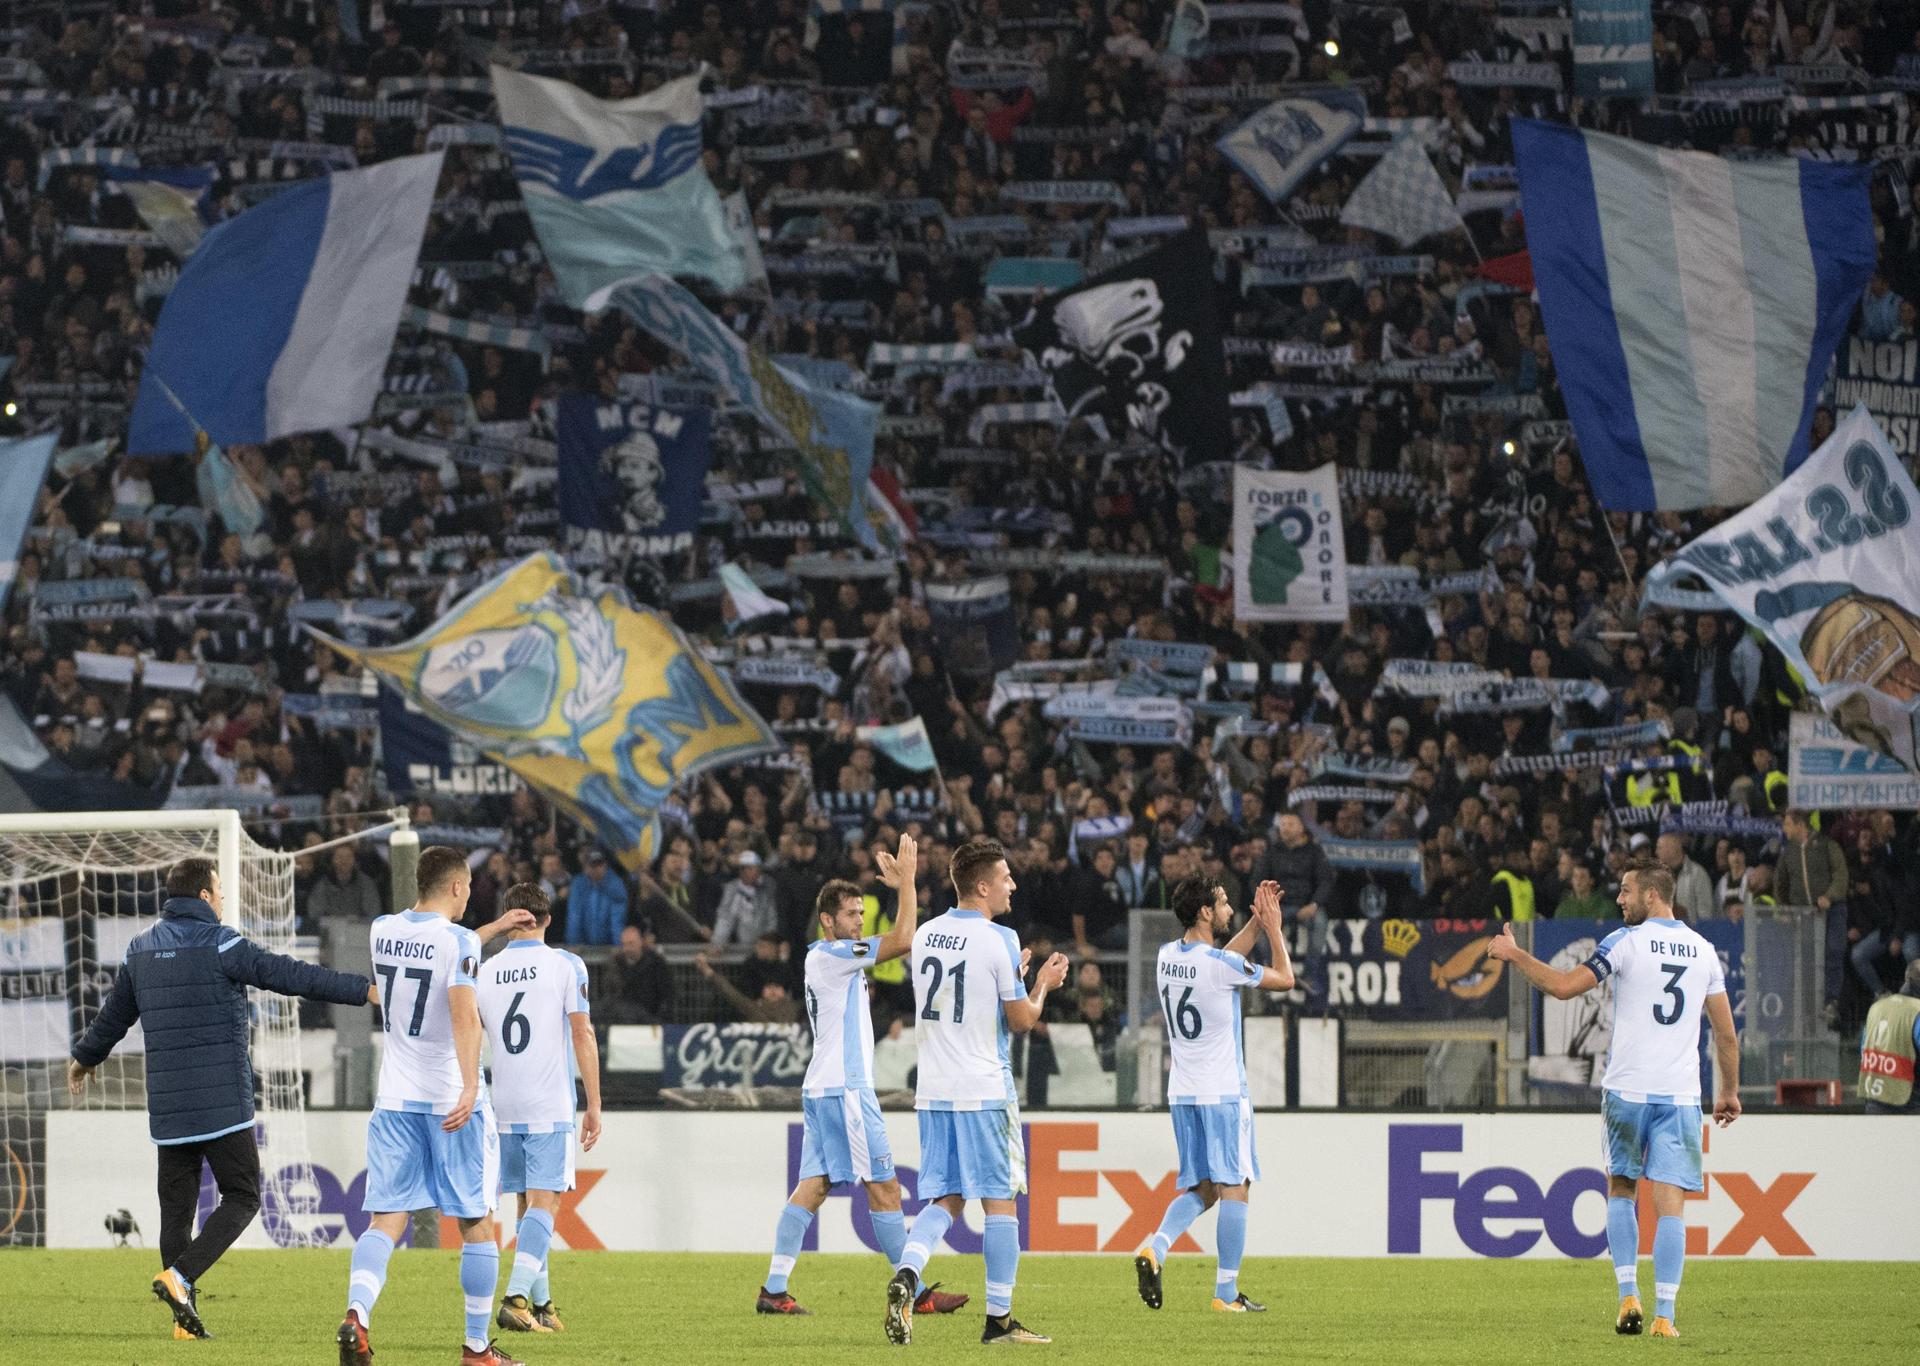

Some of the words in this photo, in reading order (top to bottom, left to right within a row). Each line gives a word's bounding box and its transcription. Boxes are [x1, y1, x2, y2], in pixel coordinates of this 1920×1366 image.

[1849, 335, 1918, 382] NOI
[595, 404, 684, 441] MCM
[375, 937, 434, 960] MARUSIC
[925, 933, 967, 951] SERGEJ
[1651, 939, 1665, 955] DE
[1669, 942, 1698, 958] VRIJ
[496, 966, 537, 985] LUCAS
[921, 956, 967, 1024] 21
[1161, 961, 1197, 979] PAROLO
[1328, 961, 1401, 1005] ROI
[375, 963, 433, 1036] 77
[1161, 984, 1203, 1040] 16
[1652, 963, 1688, 1026] 3
[502, 991, 531, 1055] 6
